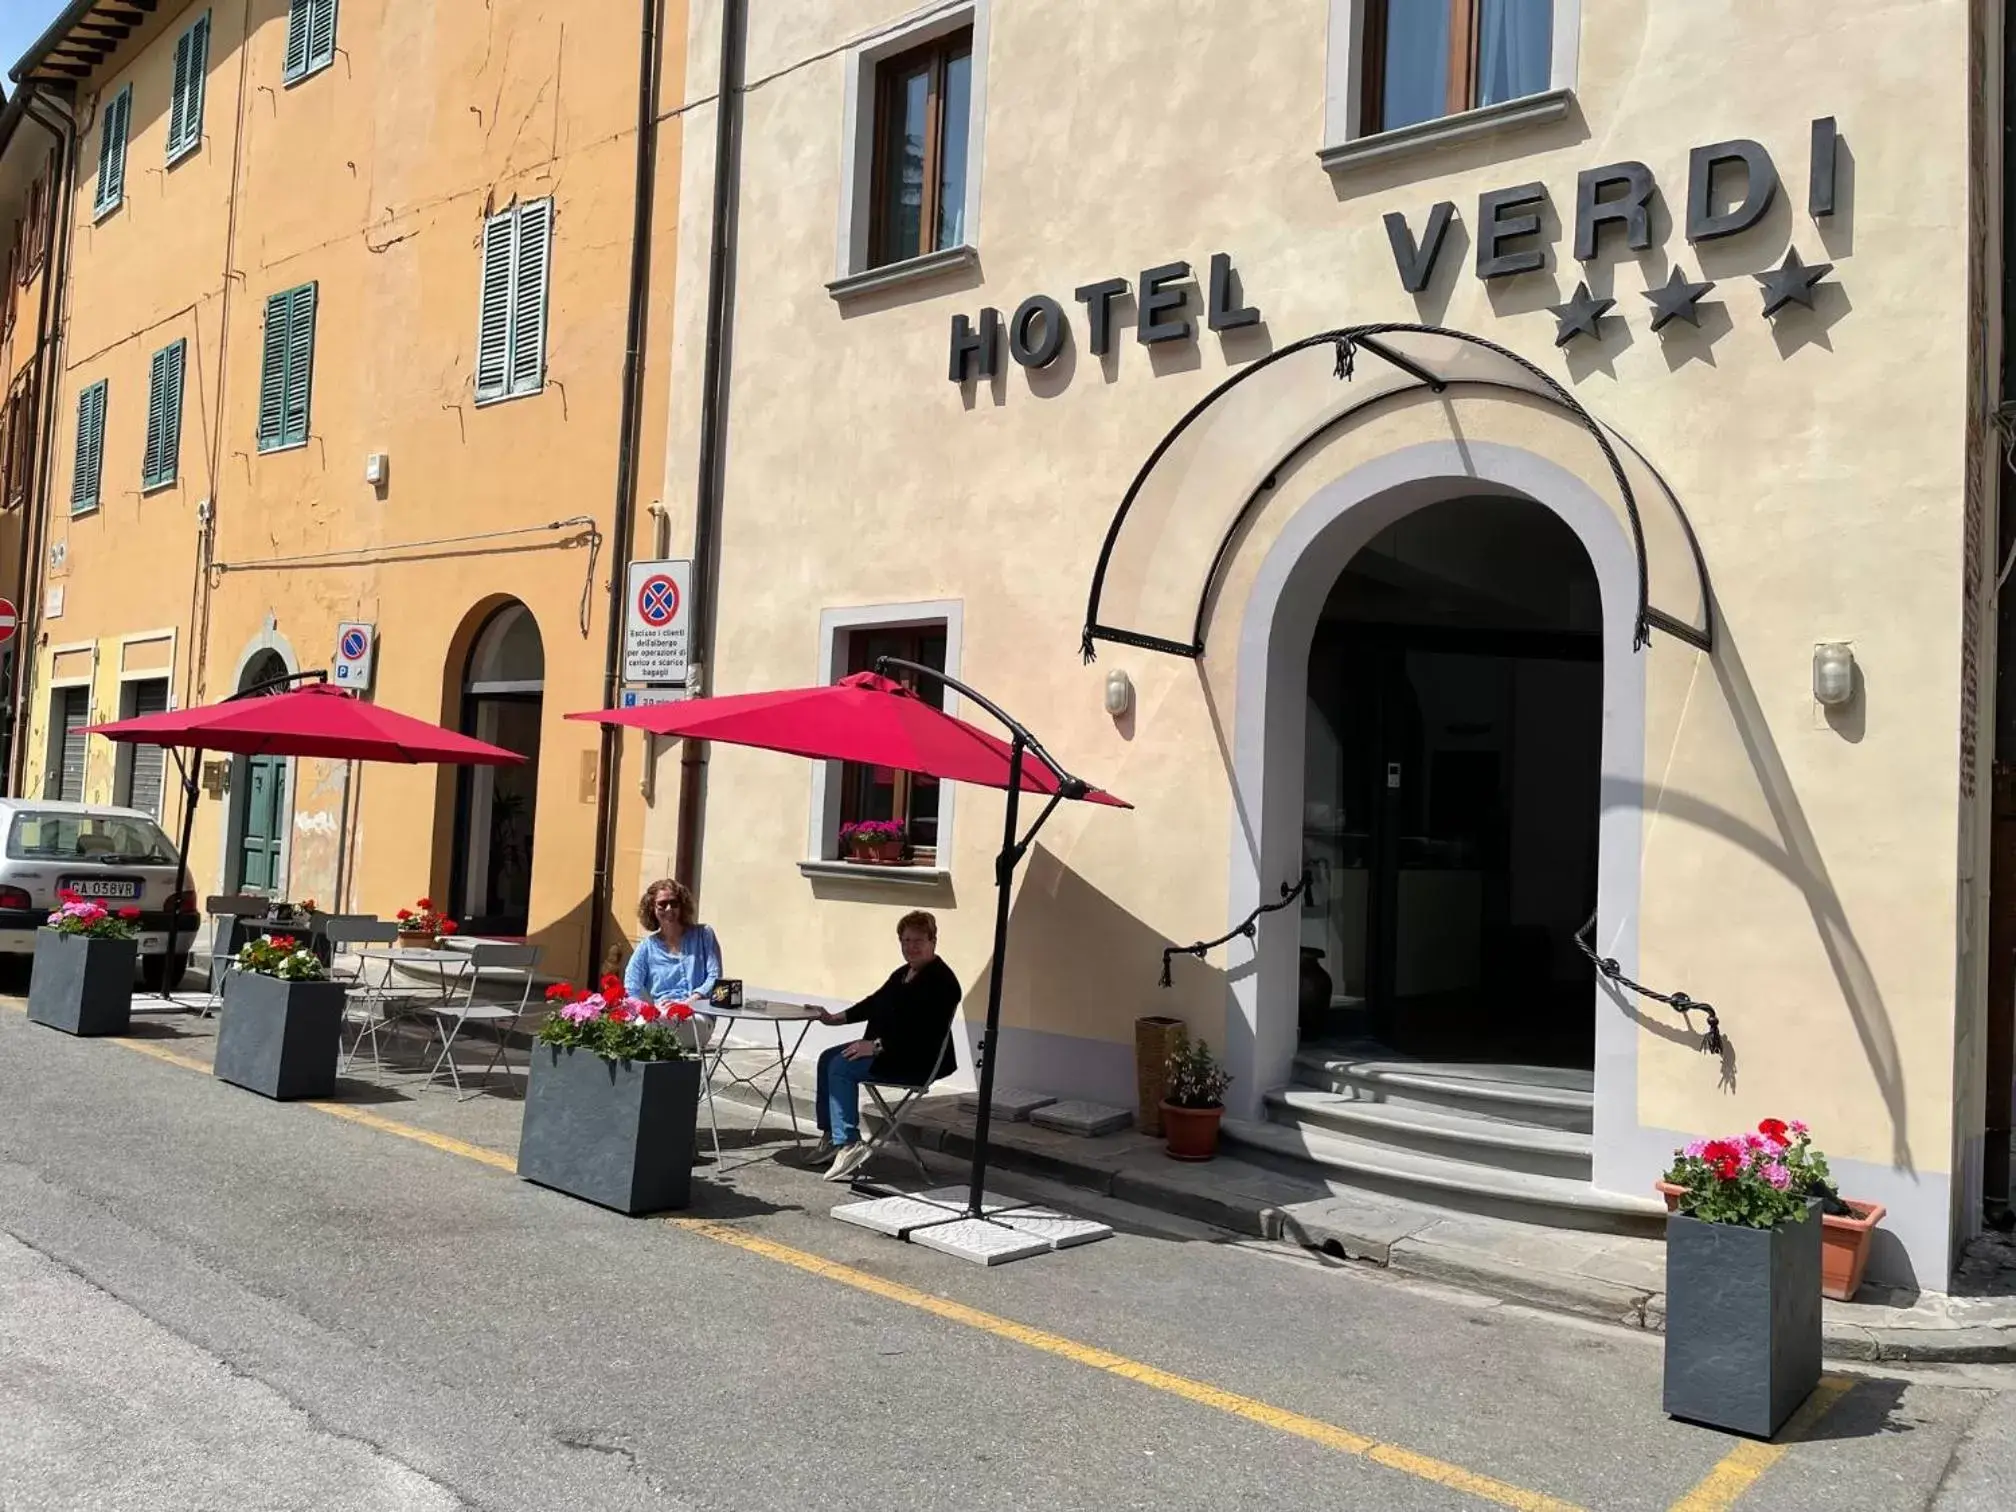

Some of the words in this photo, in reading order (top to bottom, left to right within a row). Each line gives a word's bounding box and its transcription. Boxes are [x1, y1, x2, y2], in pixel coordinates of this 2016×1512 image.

[949, 252, 1261, 382] HOTEL
[1382, 116, 1836, 293] VERDI
[641, 649, 677, 657] operazioni
[642, 668, 669, 677] bagagli
